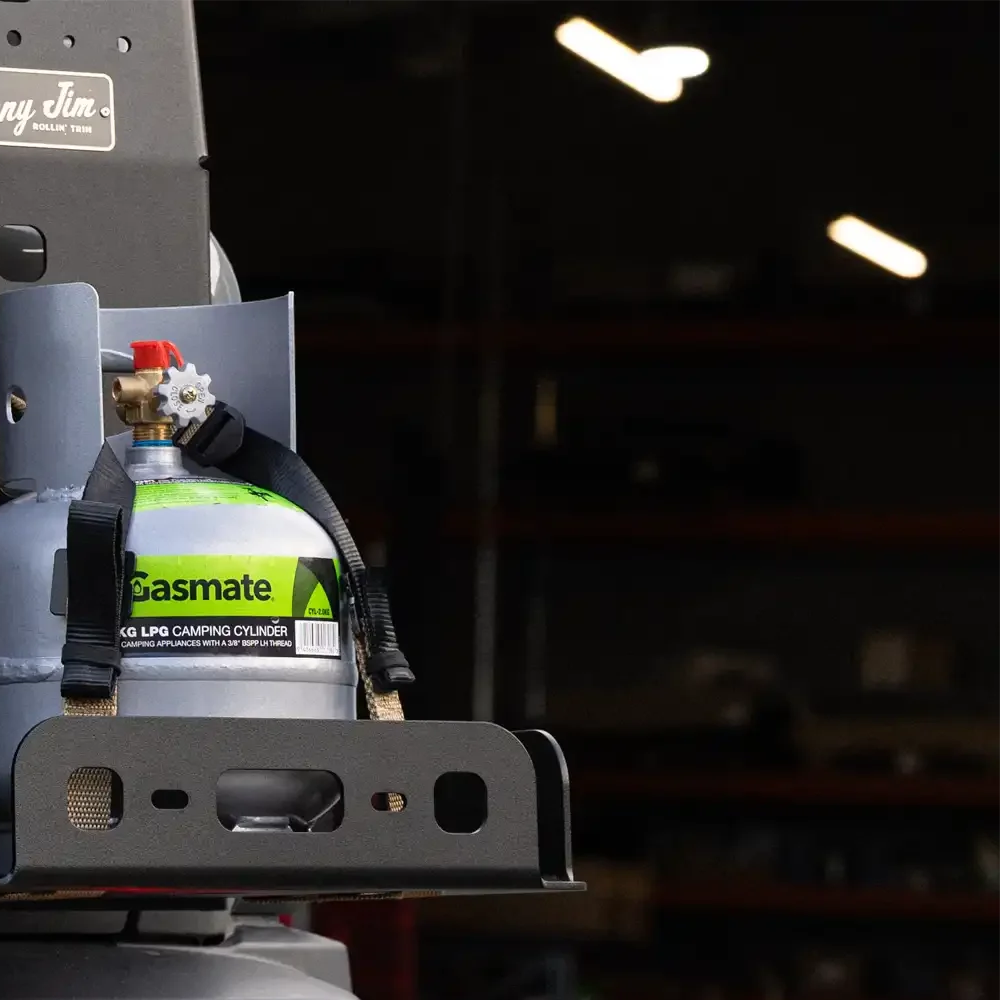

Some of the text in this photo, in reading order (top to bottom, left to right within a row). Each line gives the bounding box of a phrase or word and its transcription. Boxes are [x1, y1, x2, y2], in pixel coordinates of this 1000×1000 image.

[42, 81, 97, 119] Jim
[70, 124, 93, 134] TRIM
[130, 571, 272, 602] Gasmate
[141, 625, 169, 637] LPG
[172, 625, 231, 637] CAMPING
[234, 625, 288, 637] CYLINDER
[121, 640, 155, 648] CAMPING
